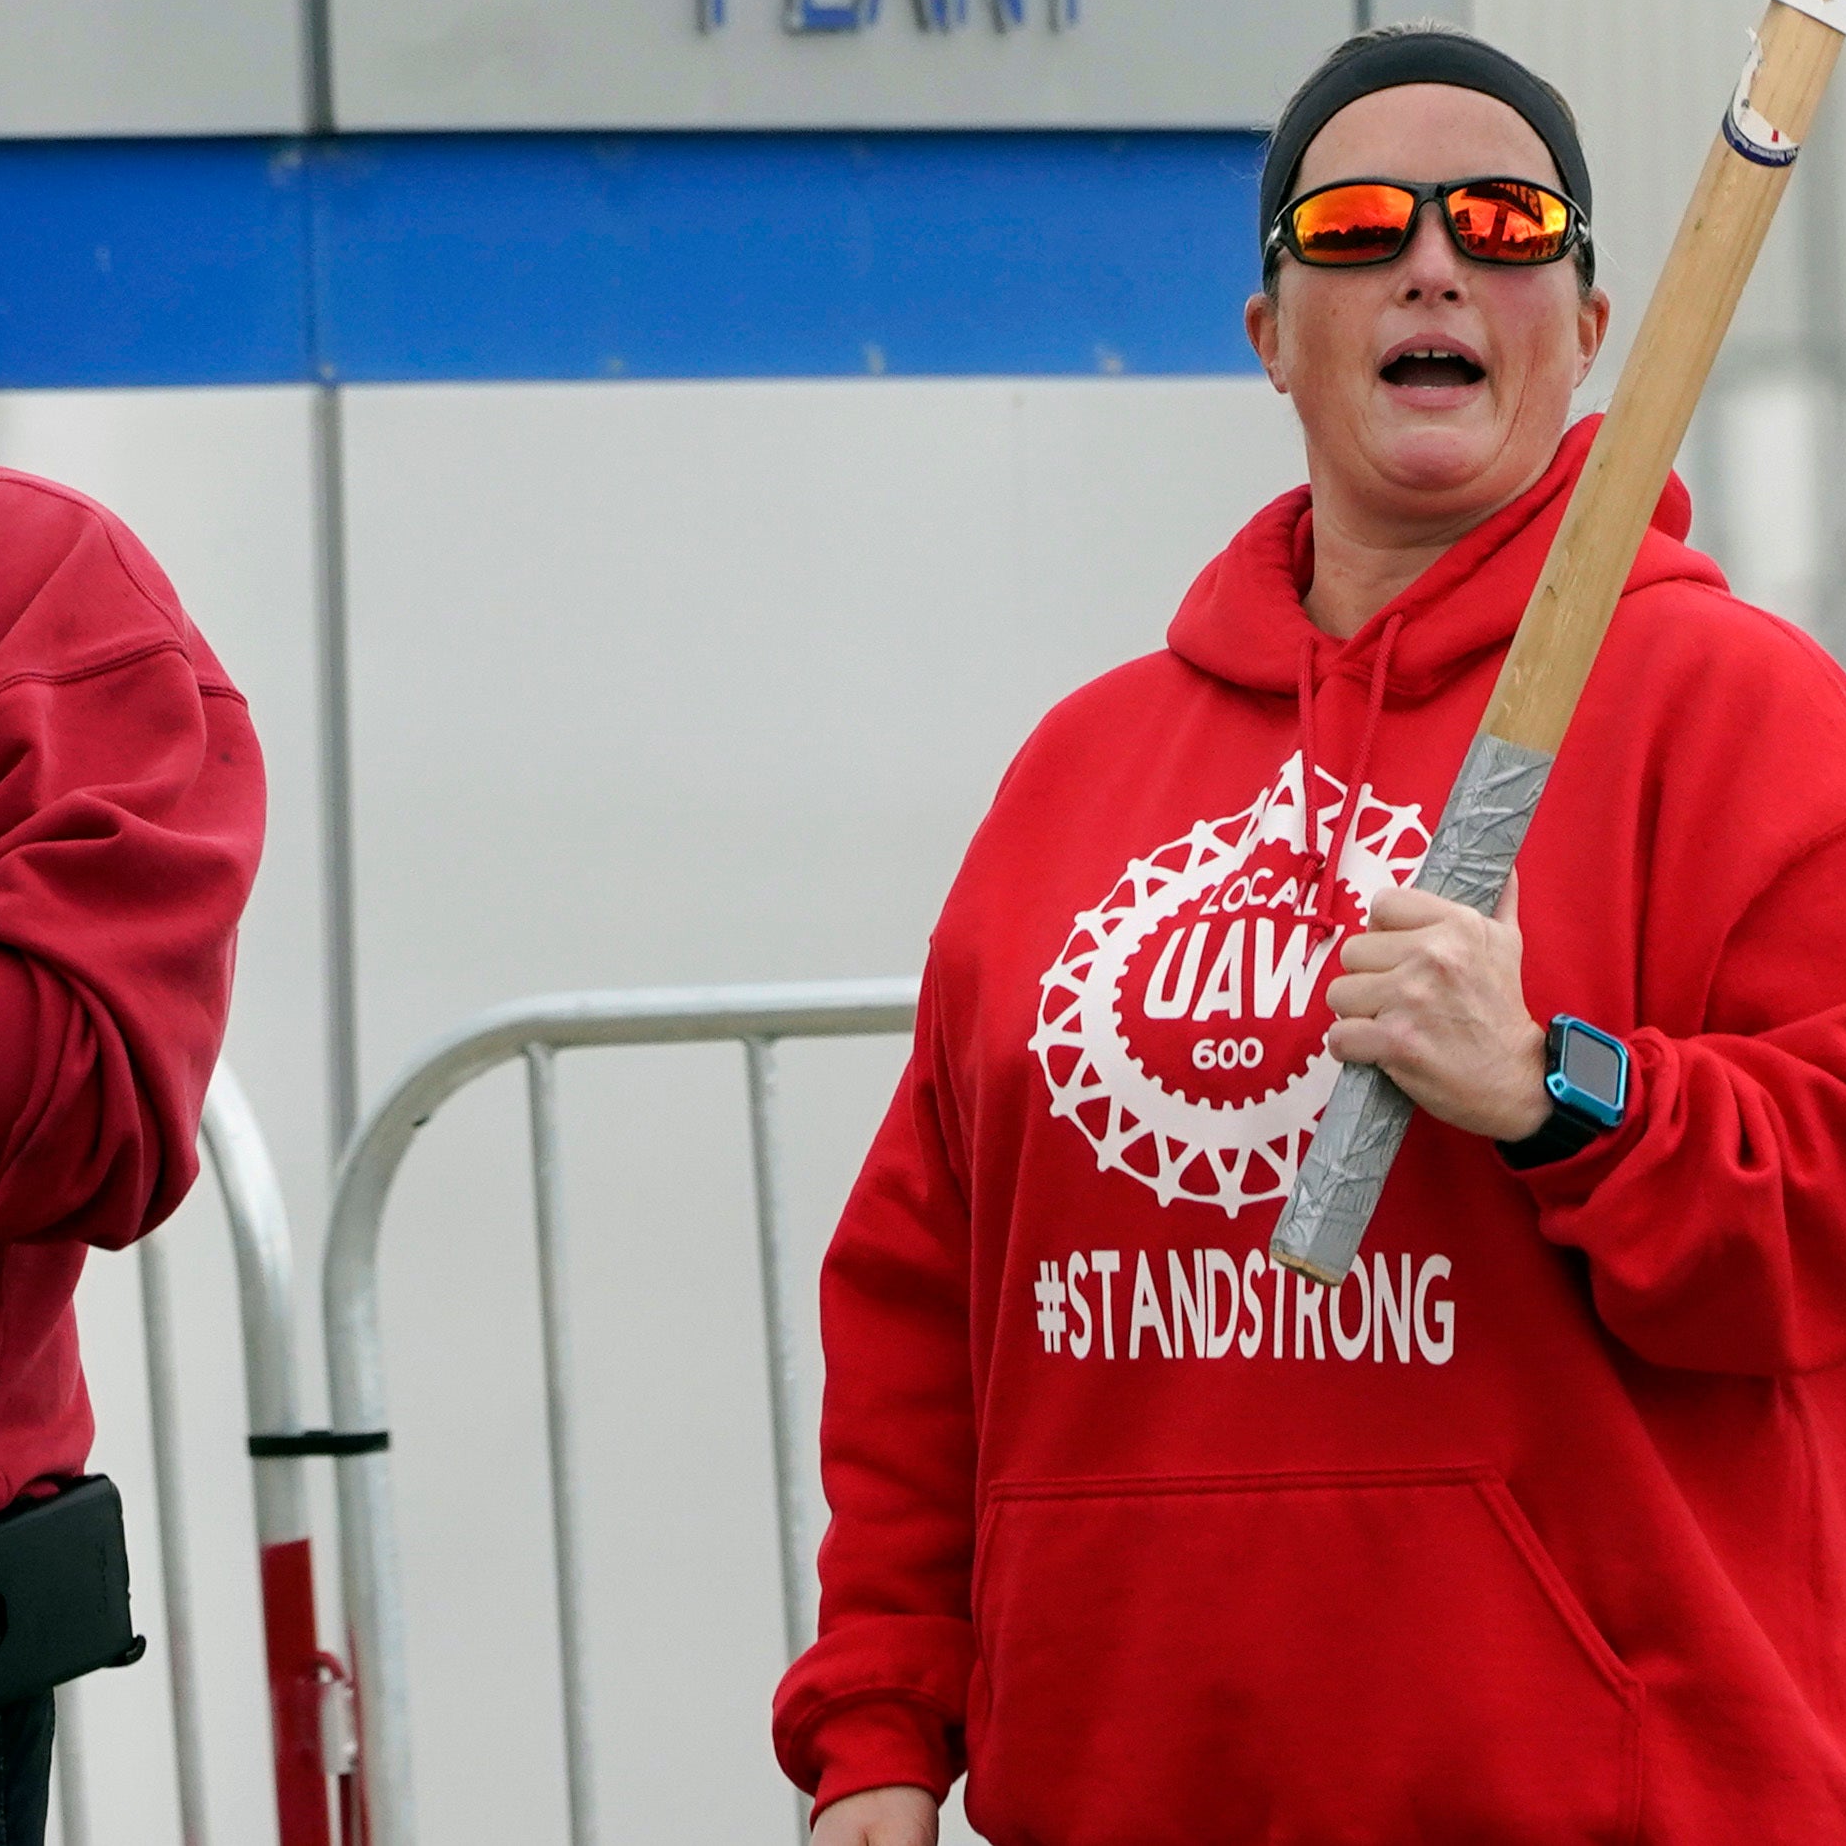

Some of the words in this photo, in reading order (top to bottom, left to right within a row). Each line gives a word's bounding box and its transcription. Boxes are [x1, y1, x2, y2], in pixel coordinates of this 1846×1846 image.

[1199, 867, 1319, 917] LOCAL
[1142, 916, 1346, 1022] UAW
[1191, 1036, 1265, 1071] 600
[1033, 1248, 1456, 1367] #STANDSTRONG
